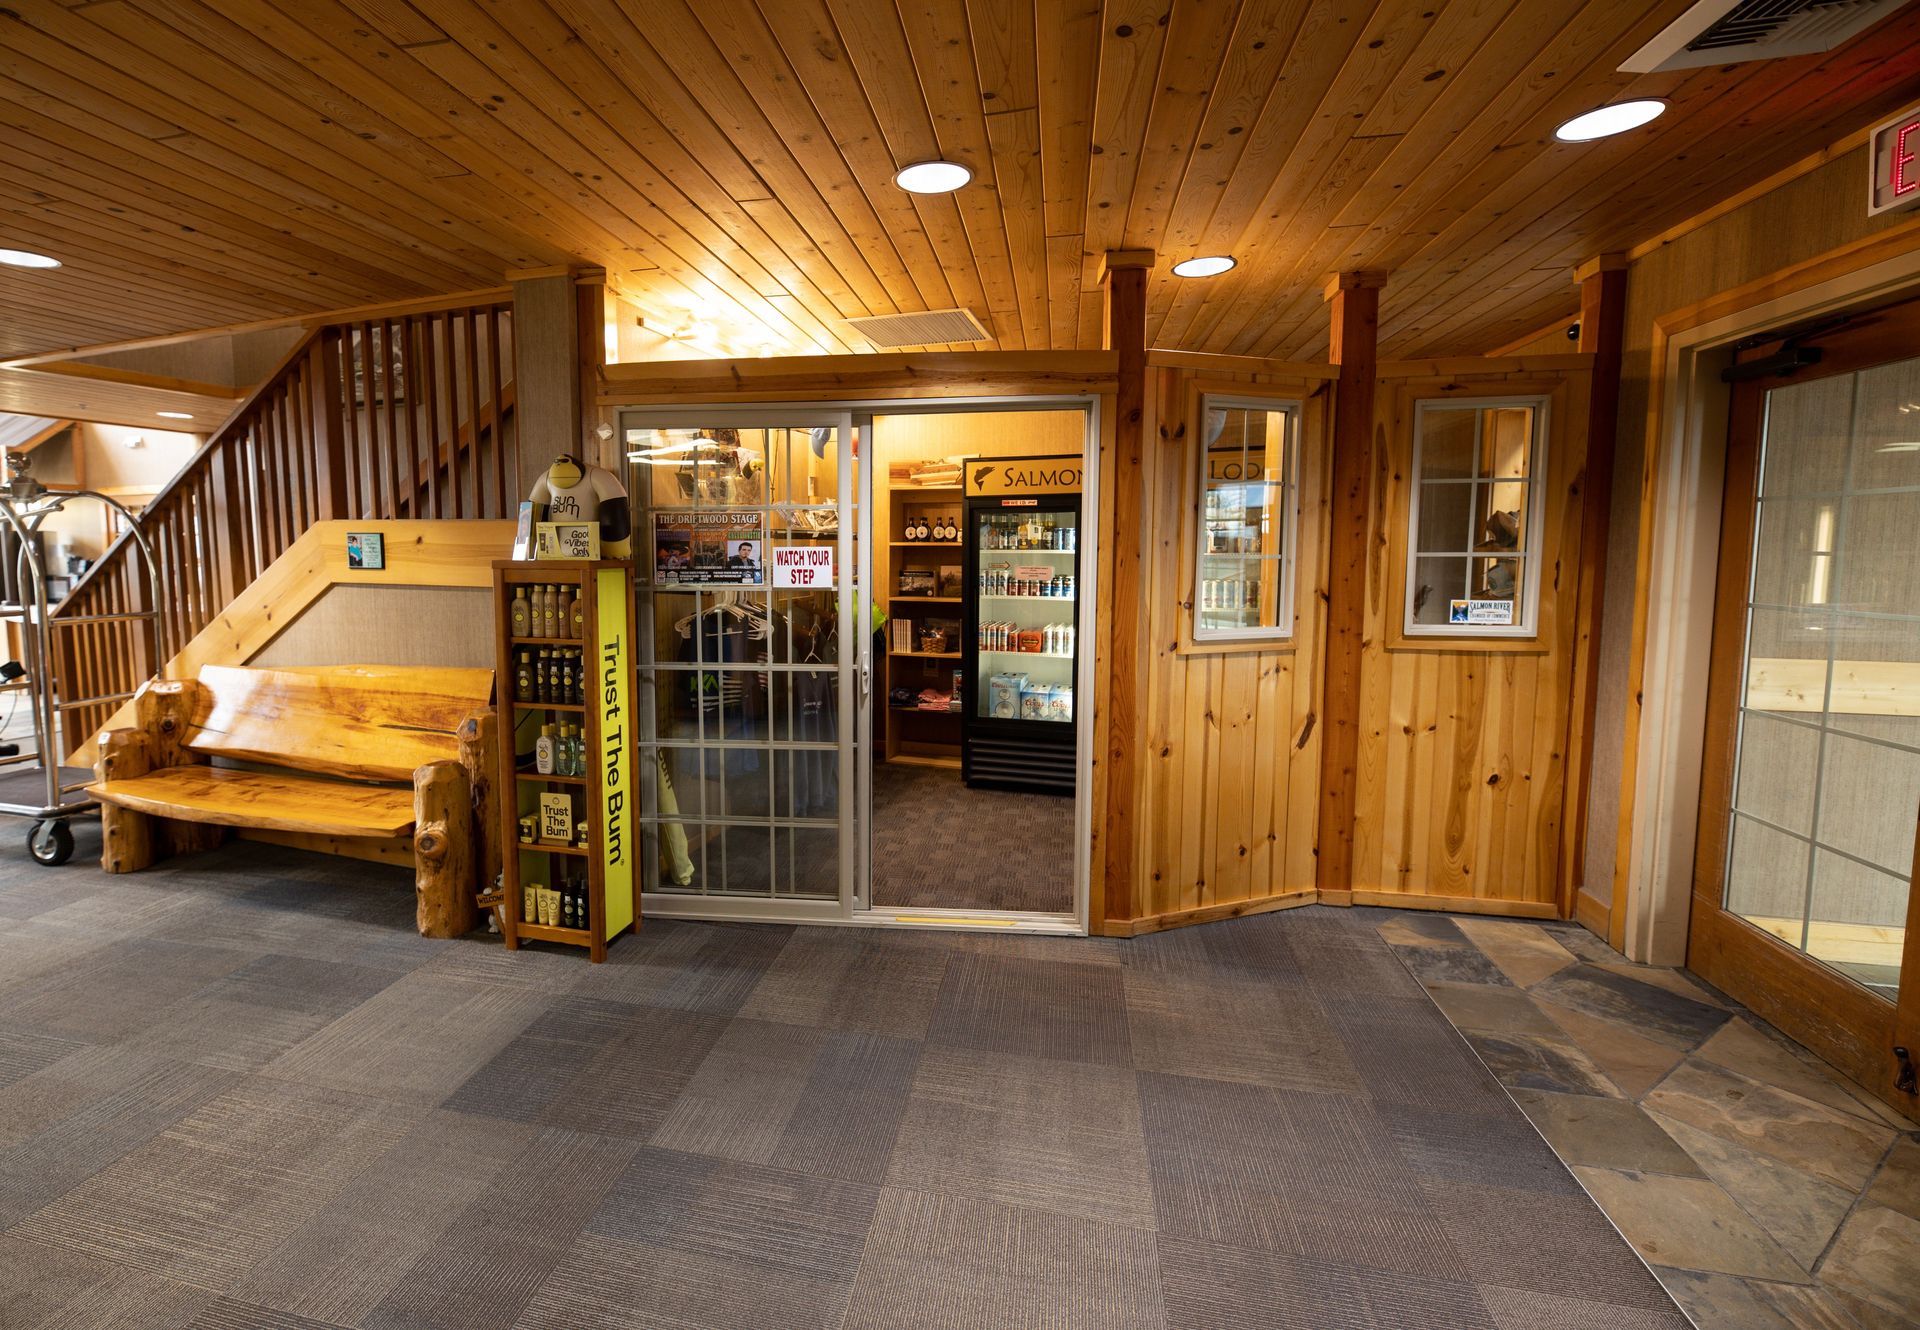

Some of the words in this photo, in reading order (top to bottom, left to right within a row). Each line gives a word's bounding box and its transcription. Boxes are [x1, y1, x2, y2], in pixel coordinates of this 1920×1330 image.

[659, 514, 676, 524] THE
[677, 514, 729, 525] DRIFTWOOD
[730, 514, 759, 524] STAGE
[776, 550, 804, 566] WATCH
[806, 550, 830, 566] YOUR
[790, 569, 815, 585] STEP
[1469, 601, 1493, 613] SALMON
[1493, 602, 1511, 613] RIVER
[604, 634, 621, 721] Trust
[606, 724, 623, 787] The
[543, 804, 569, 816] Trust
[547, 815, 566, 827] The
[608, 790, 624, 866] Bum
[546, 825, 569, 837] Bum
